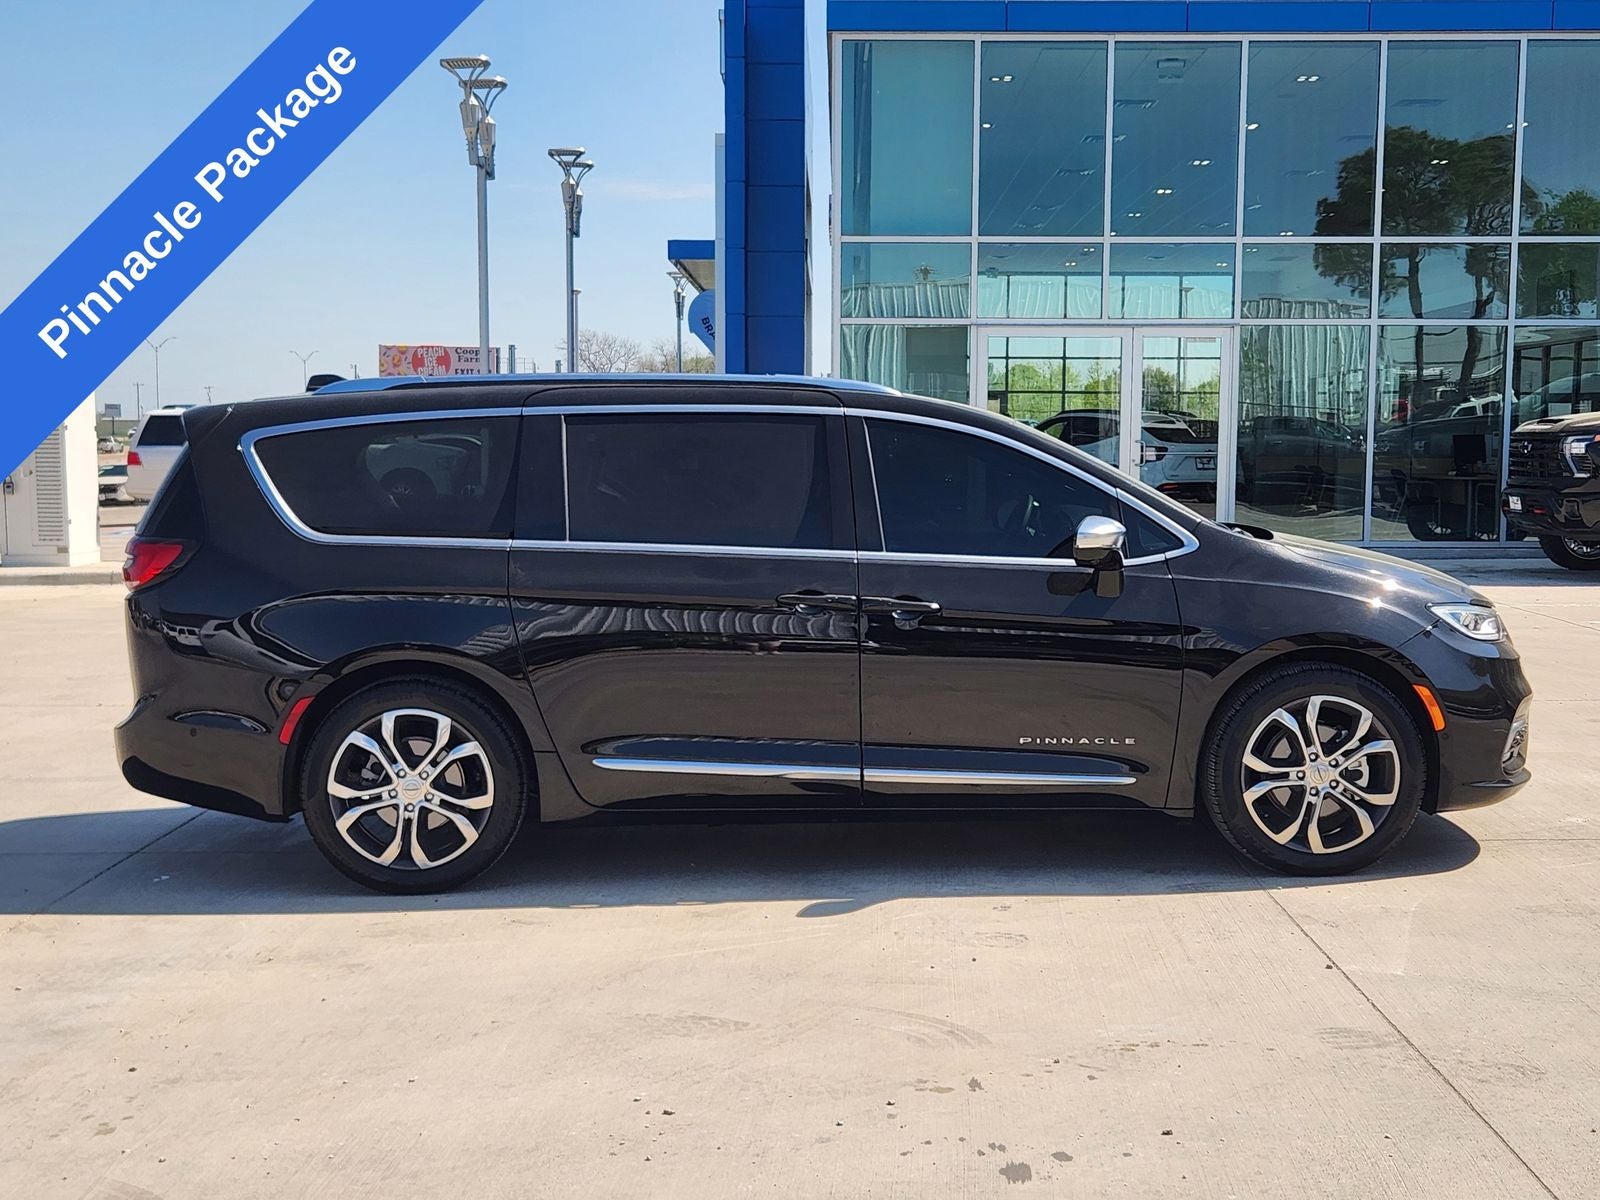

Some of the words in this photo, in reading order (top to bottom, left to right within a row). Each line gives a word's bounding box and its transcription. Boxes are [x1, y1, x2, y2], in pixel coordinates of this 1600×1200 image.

[417, 346, 445, 358] PEACH
[424, 356, 439, 367] ICE
[1019, 737, 1136, 745] PINNACLE
